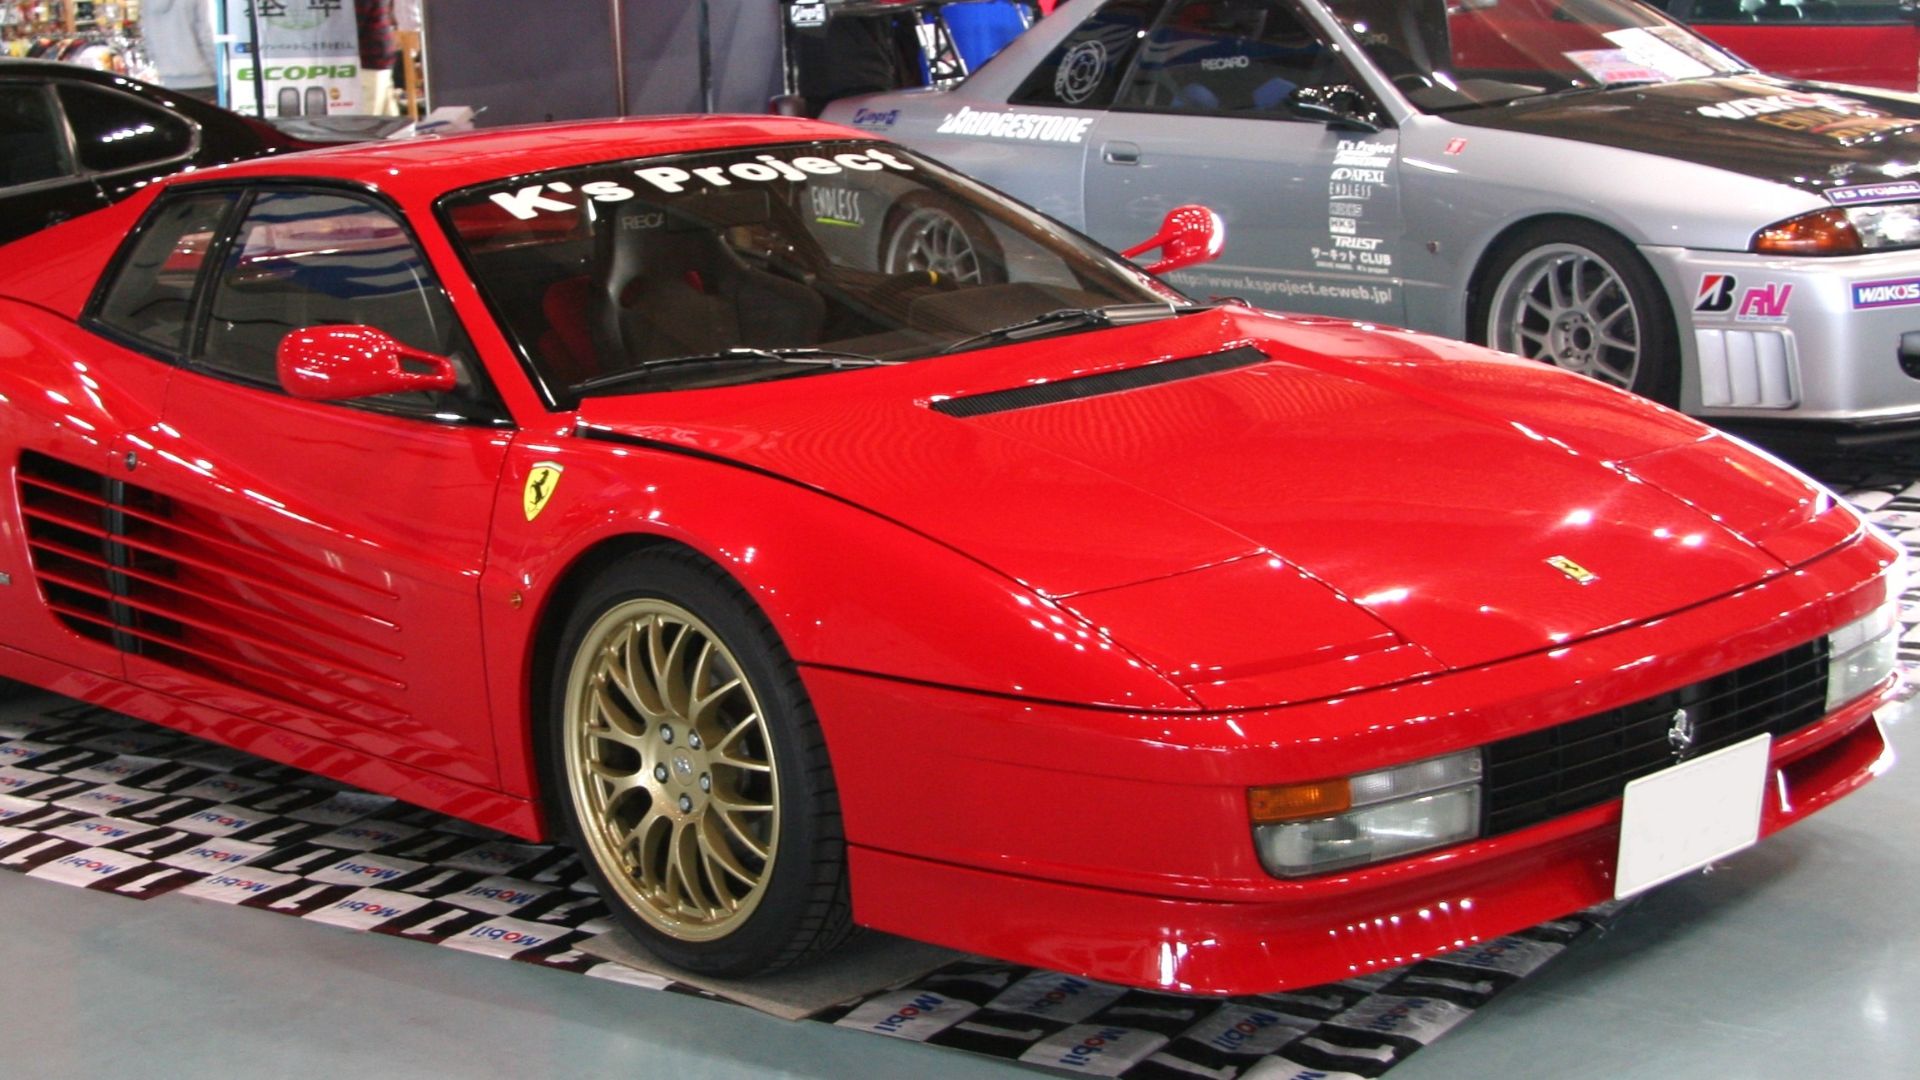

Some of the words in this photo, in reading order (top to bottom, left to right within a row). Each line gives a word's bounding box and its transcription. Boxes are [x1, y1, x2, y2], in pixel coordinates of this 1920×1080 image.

[1200, 55, 1249, 70] RECARO
[936, 106, 1093, 143] BRIDGESTONE
[489, 181, 635, 220] K's
[634, 148, 915, 193] Project
[811, 185, 860, 222] ENDLESS
[1330, 235, 1383, 250] TRUST
[1360, 252, 1392, 266] CLUB
[58, 855, 121, 874] Mobil
[334, 861, 400, 879] Mobil
[206, 875, 271, 892] Mobil
[466, 886, 535, 905] Mobil
[333, 900, 401, 918] Mobil
[470, 926, 542, 946] Mobil
[874, 993, 944, 1033] Mobil
[1212, 1002, 1279, 1050] Mobil
[1059, 1027, 1129, 1066] Mobil
